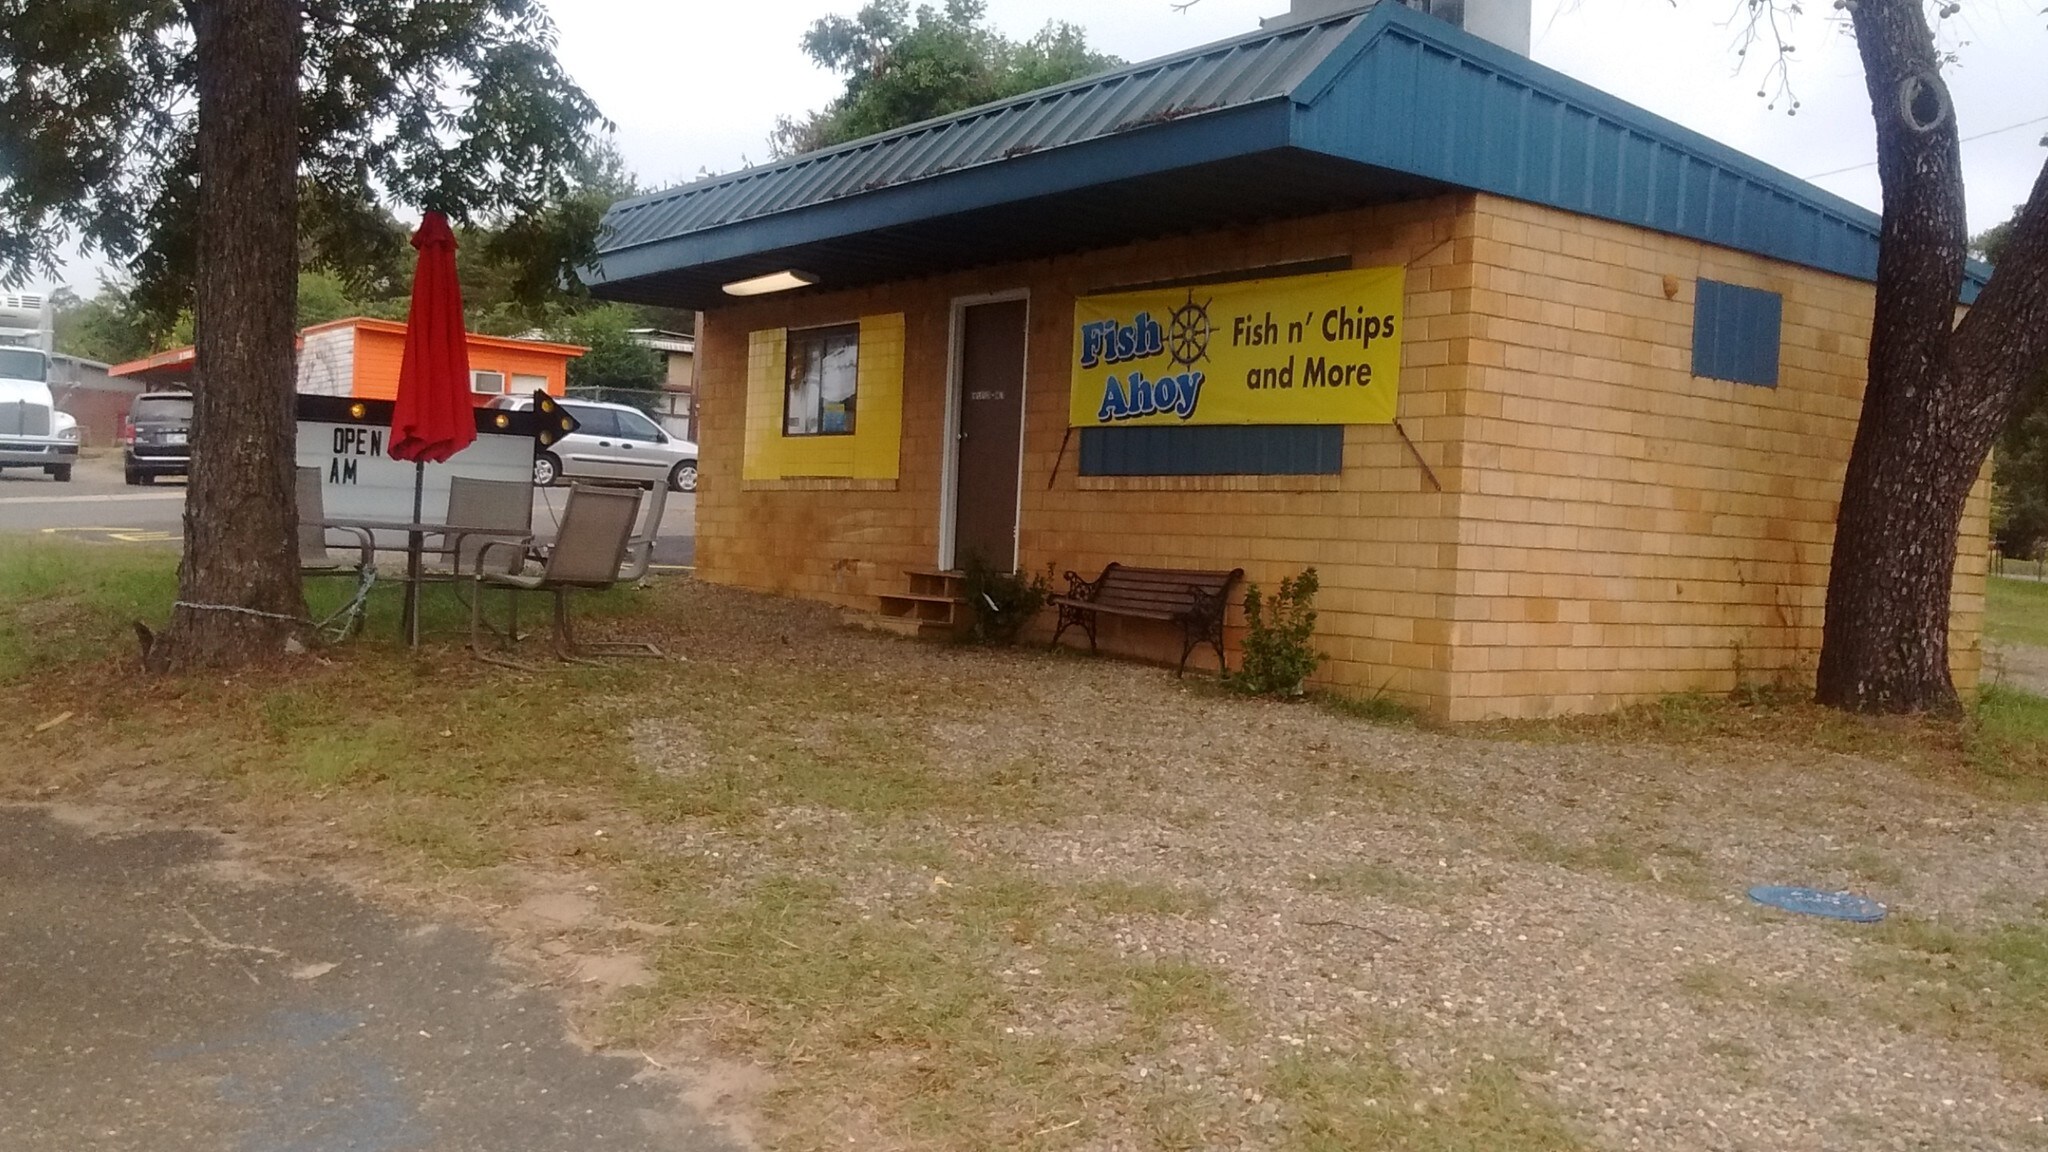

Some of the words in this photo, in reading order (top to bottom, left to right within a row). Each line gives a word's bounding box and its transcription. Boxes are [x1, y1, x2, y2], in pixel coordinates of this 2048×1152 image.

[1080, 311, 1164, 368] Fish
[1232, 312, 1278, 347] Fish
[1322, 306, 1395, 349] Chips
[1247, 355, 1294, 390] and
[1303, 356, 1372, 388] More
[1098, 371, 1206, 423] Ahoy
[333, 427, 382, 457] OPEN
[329, 457, 358, 485] AM
